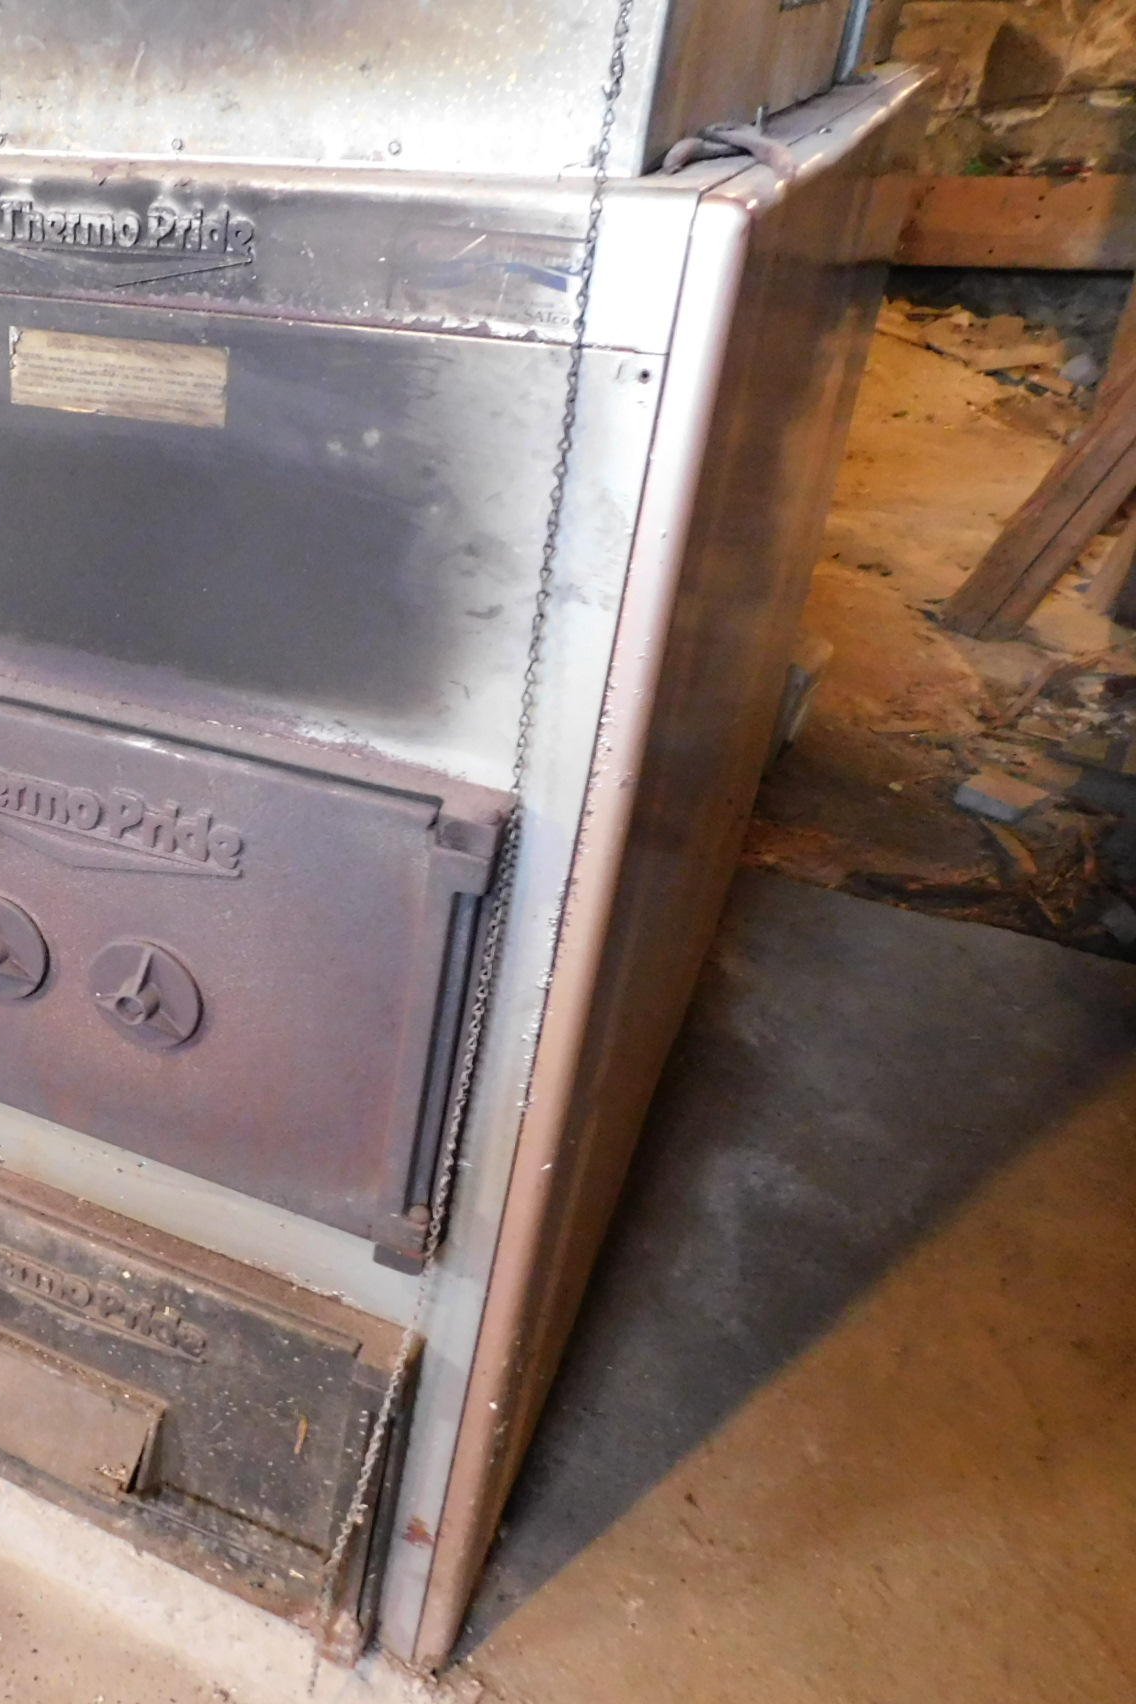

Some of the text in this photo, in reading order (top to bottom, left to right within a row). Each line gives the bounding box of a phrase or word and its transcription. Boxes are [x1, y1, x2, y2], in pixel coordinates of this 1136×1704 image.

[147, 197, 255, 256] Pride
[111, 786, 244, 869] Pride
[96, 1279, 208, 1357] Pride
